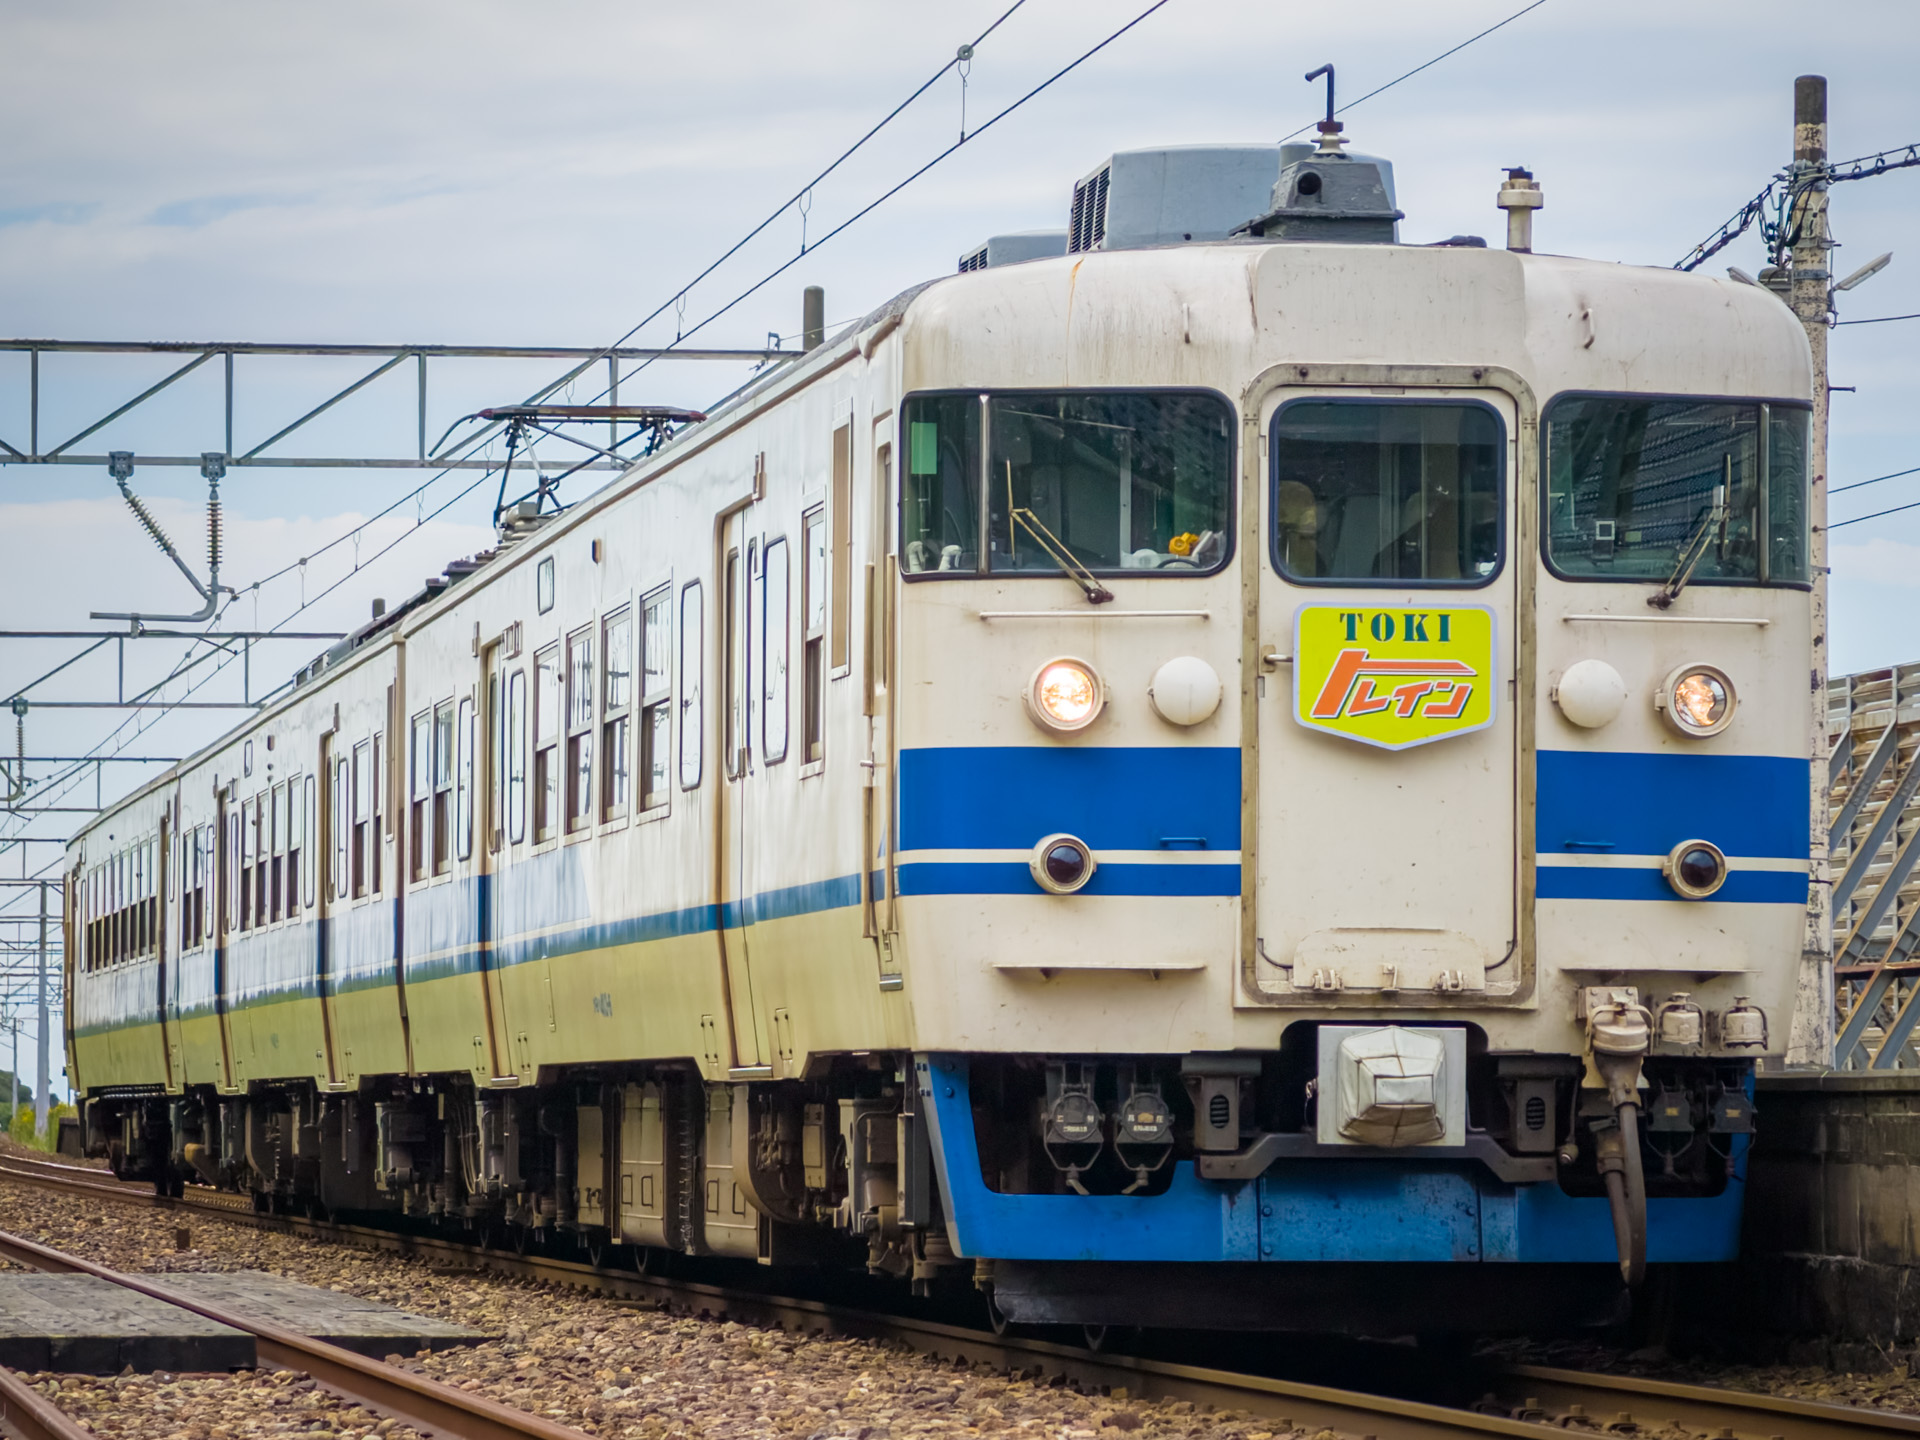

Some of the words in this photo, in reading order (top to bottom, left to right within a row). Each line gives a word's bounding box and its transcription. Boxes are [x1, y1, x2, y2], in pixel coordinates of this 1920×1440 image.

[1340, 613, 1451, 642] TOKI
[1310, 648, 1478, 718] トレイン
